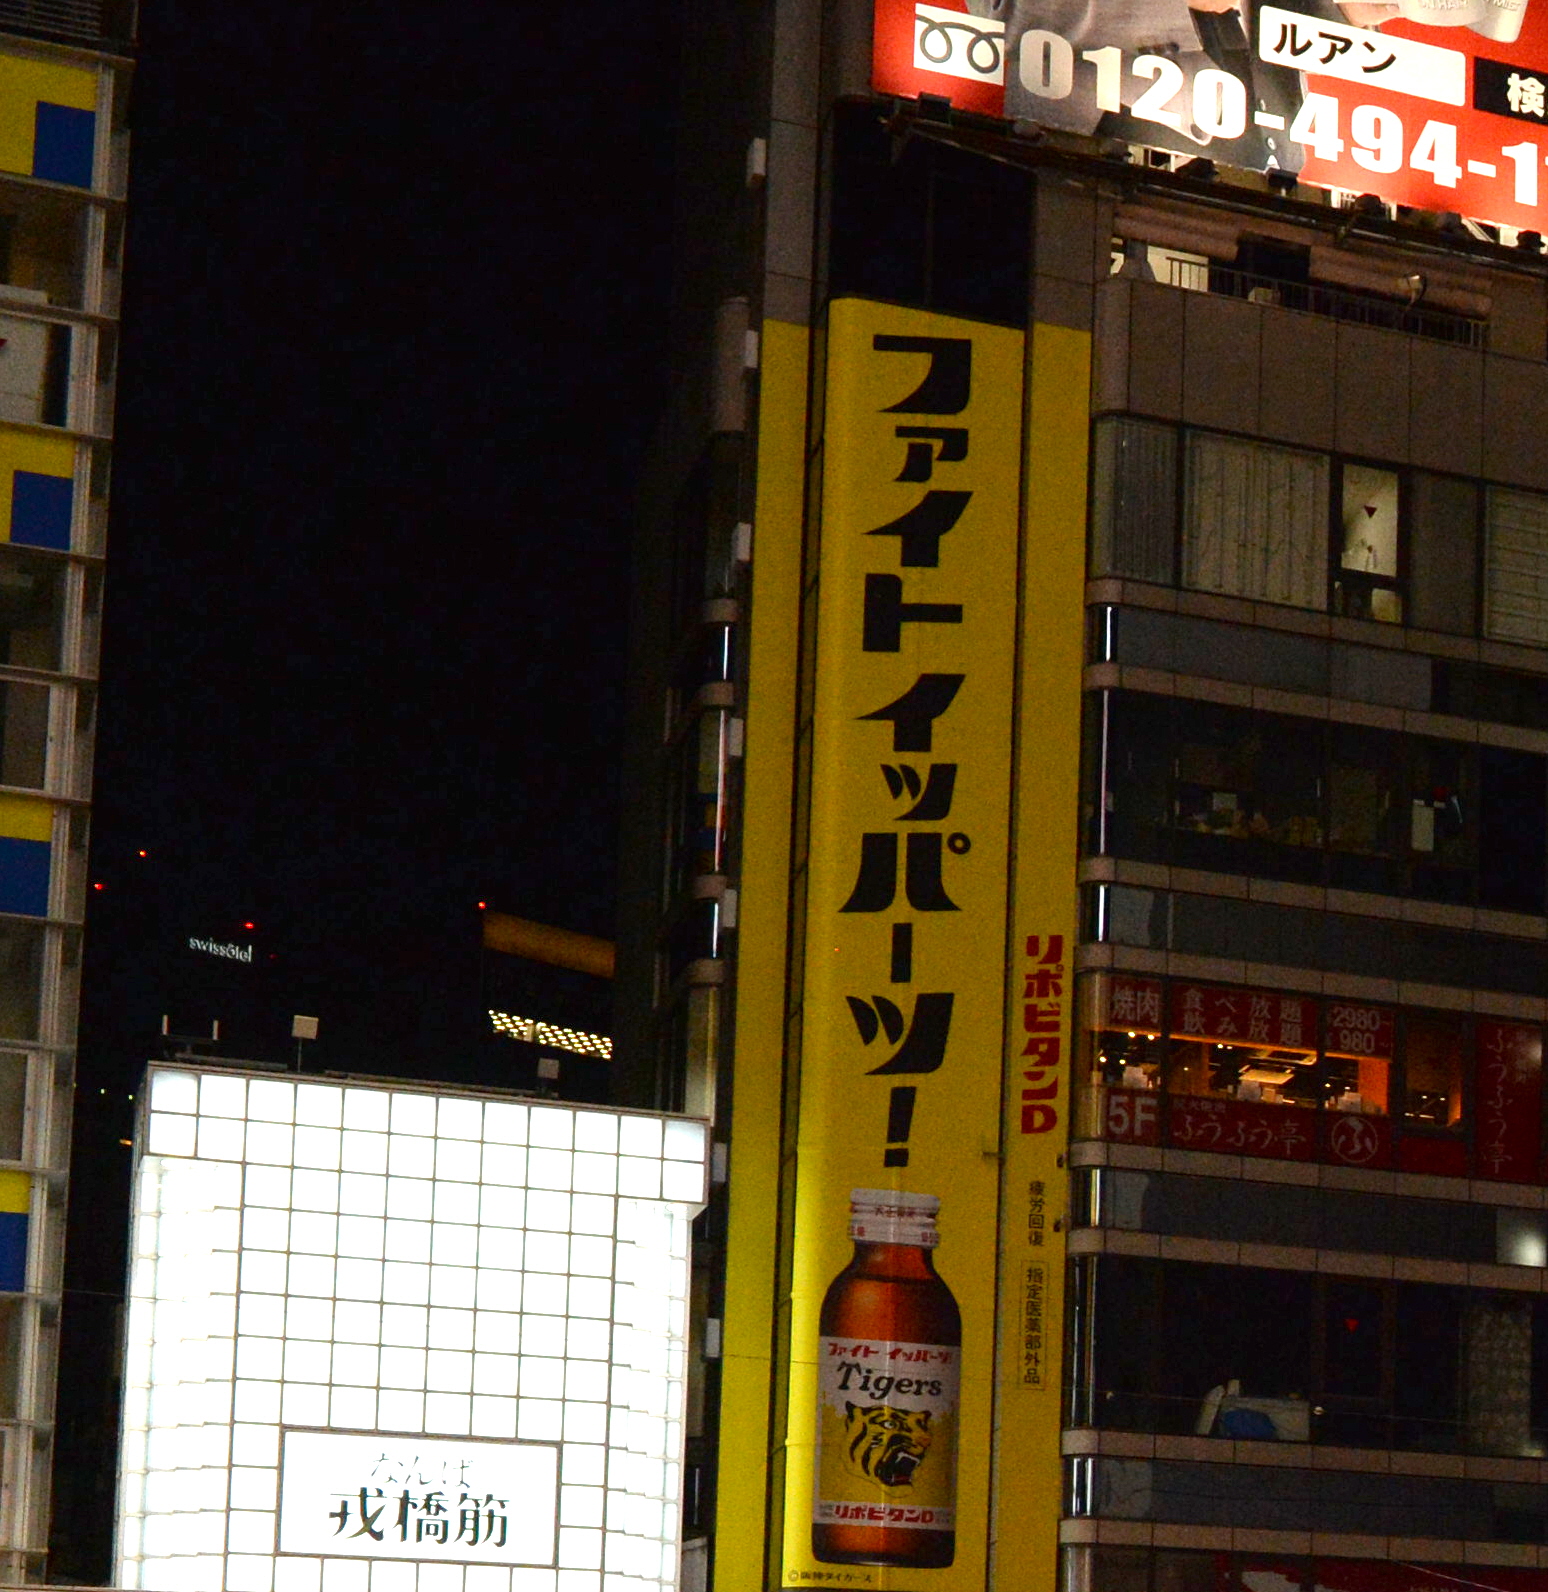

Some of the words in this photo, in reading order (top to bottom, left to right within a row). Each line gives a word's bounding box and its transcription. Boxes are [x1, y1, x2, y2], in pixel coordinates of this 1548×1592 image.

[1272, 22, 1396, 74] ルアン
[1113, 985, 1160, 1024] 焼肉
[1183, 989, 1302, 1022] 食べ放題
[1019, 933, 1064, 1136] リポビタンD
[1183, 1012, 1302, 1047] 飲み放題
[1108, 1096, 1158, 1137] 5F
[1172, 1113, 1306, 1155] ふうふう亭
[1023, 1267, 1045, 1386] 指定医薬部外品
[837, 1360, 943, 1400] Tigers
[371, 1452, 474, 1489] なんば
[329, 1486, 510, 1548] 戎橋筋
[833, 1504, 934, 1524] リポビタンD
